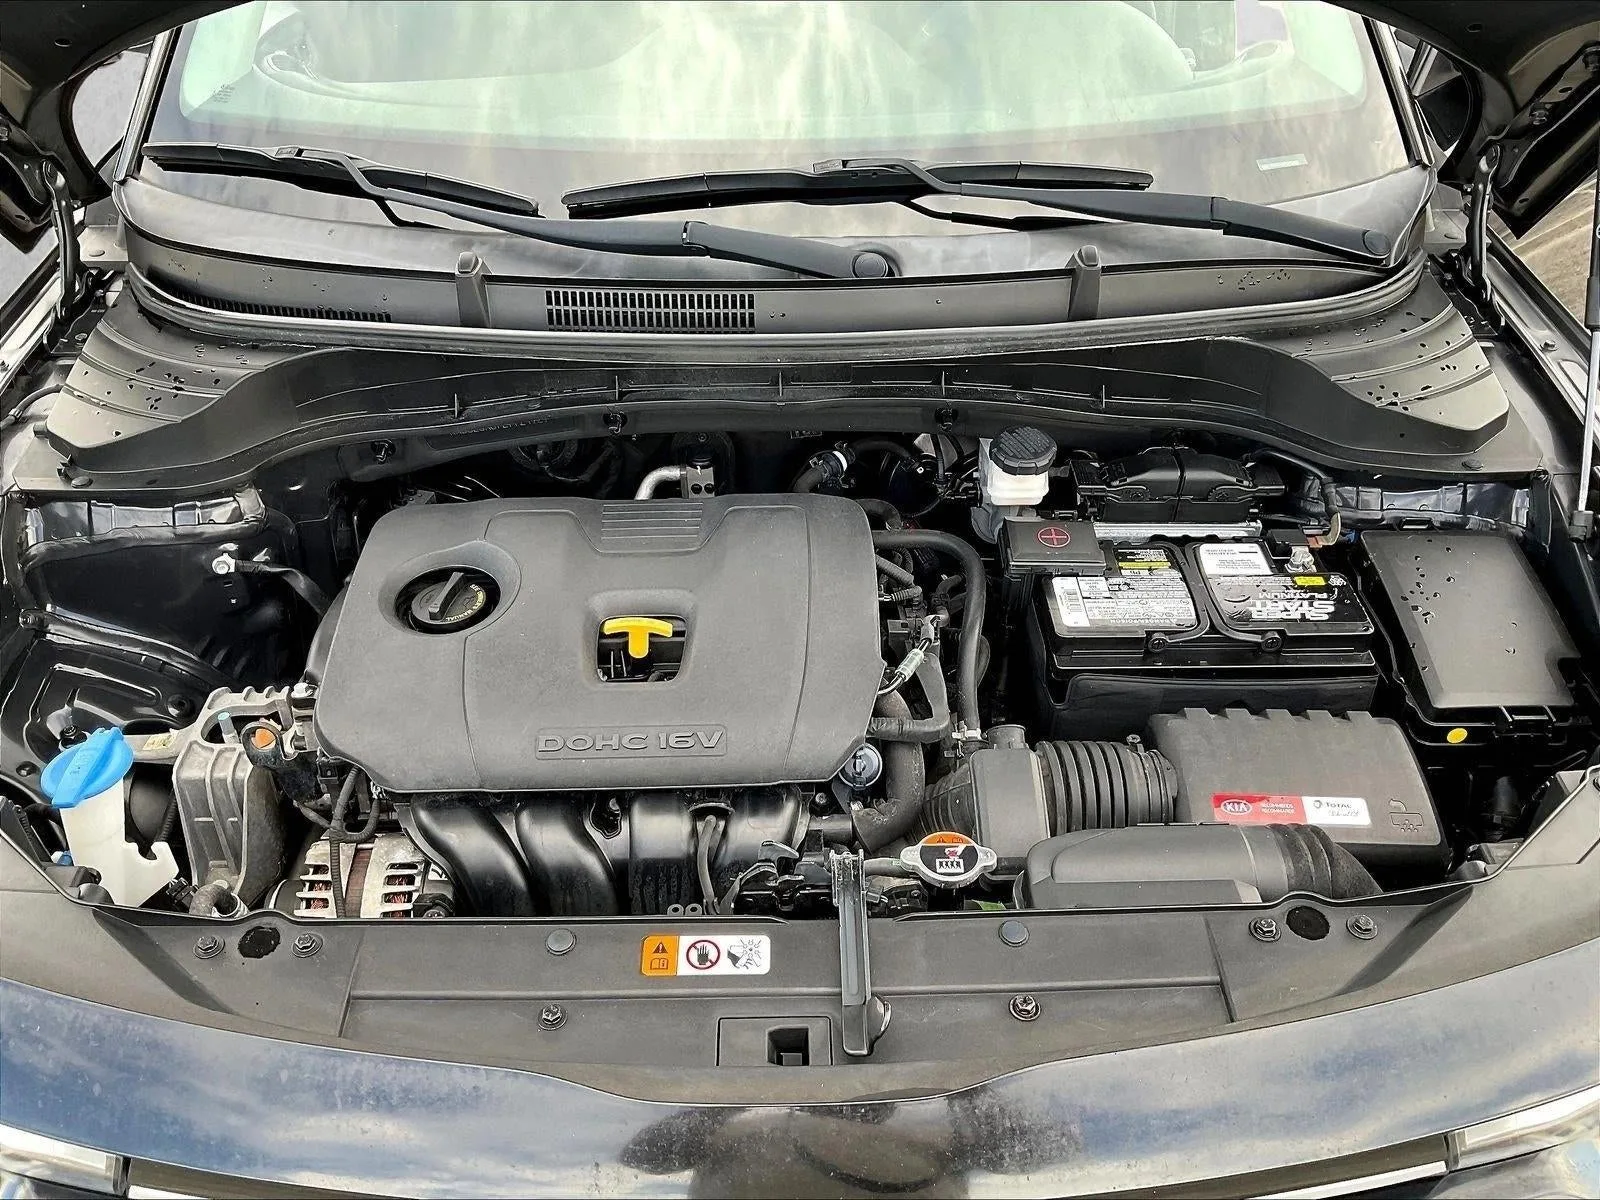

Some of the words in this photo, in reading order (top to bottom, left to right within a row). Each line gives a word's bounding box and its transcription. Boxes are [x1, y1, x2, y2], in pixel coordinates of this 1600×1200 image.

[1247, 600, 1335, 612] START
[1251, 609, 1330, 621] SUPER
[537, 733, 649, 752] DOHC
[658, 730, 724, 750] 16V
[1225, 802, 1248, 813] KIA
